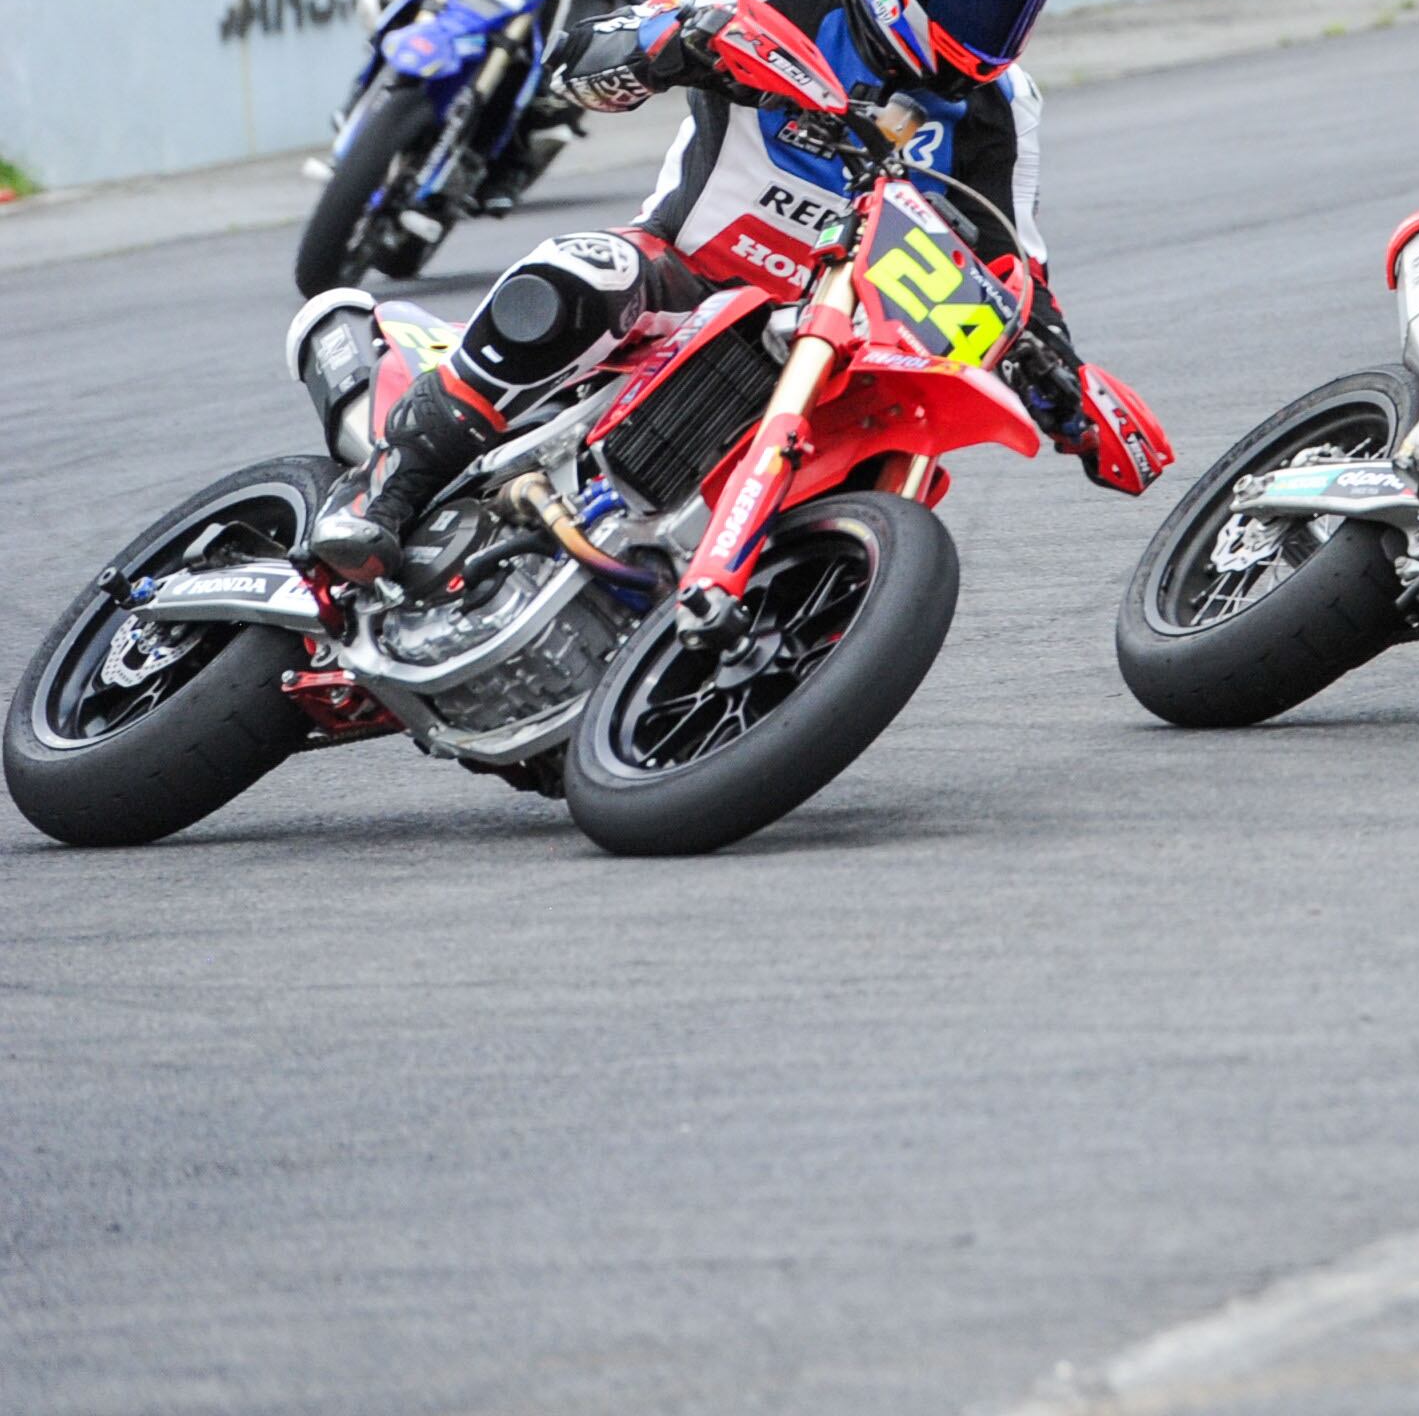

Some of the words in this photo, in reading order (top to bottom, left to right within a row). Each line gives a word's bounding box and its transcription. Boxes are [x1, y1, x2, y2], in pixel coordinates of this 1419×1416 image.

[730, 233, 812, 290] HON
[863, 226, 1006, 368] 24
[710, 477, 763, 559] REPSOL
[190, 576, 267, 595] HONDA
